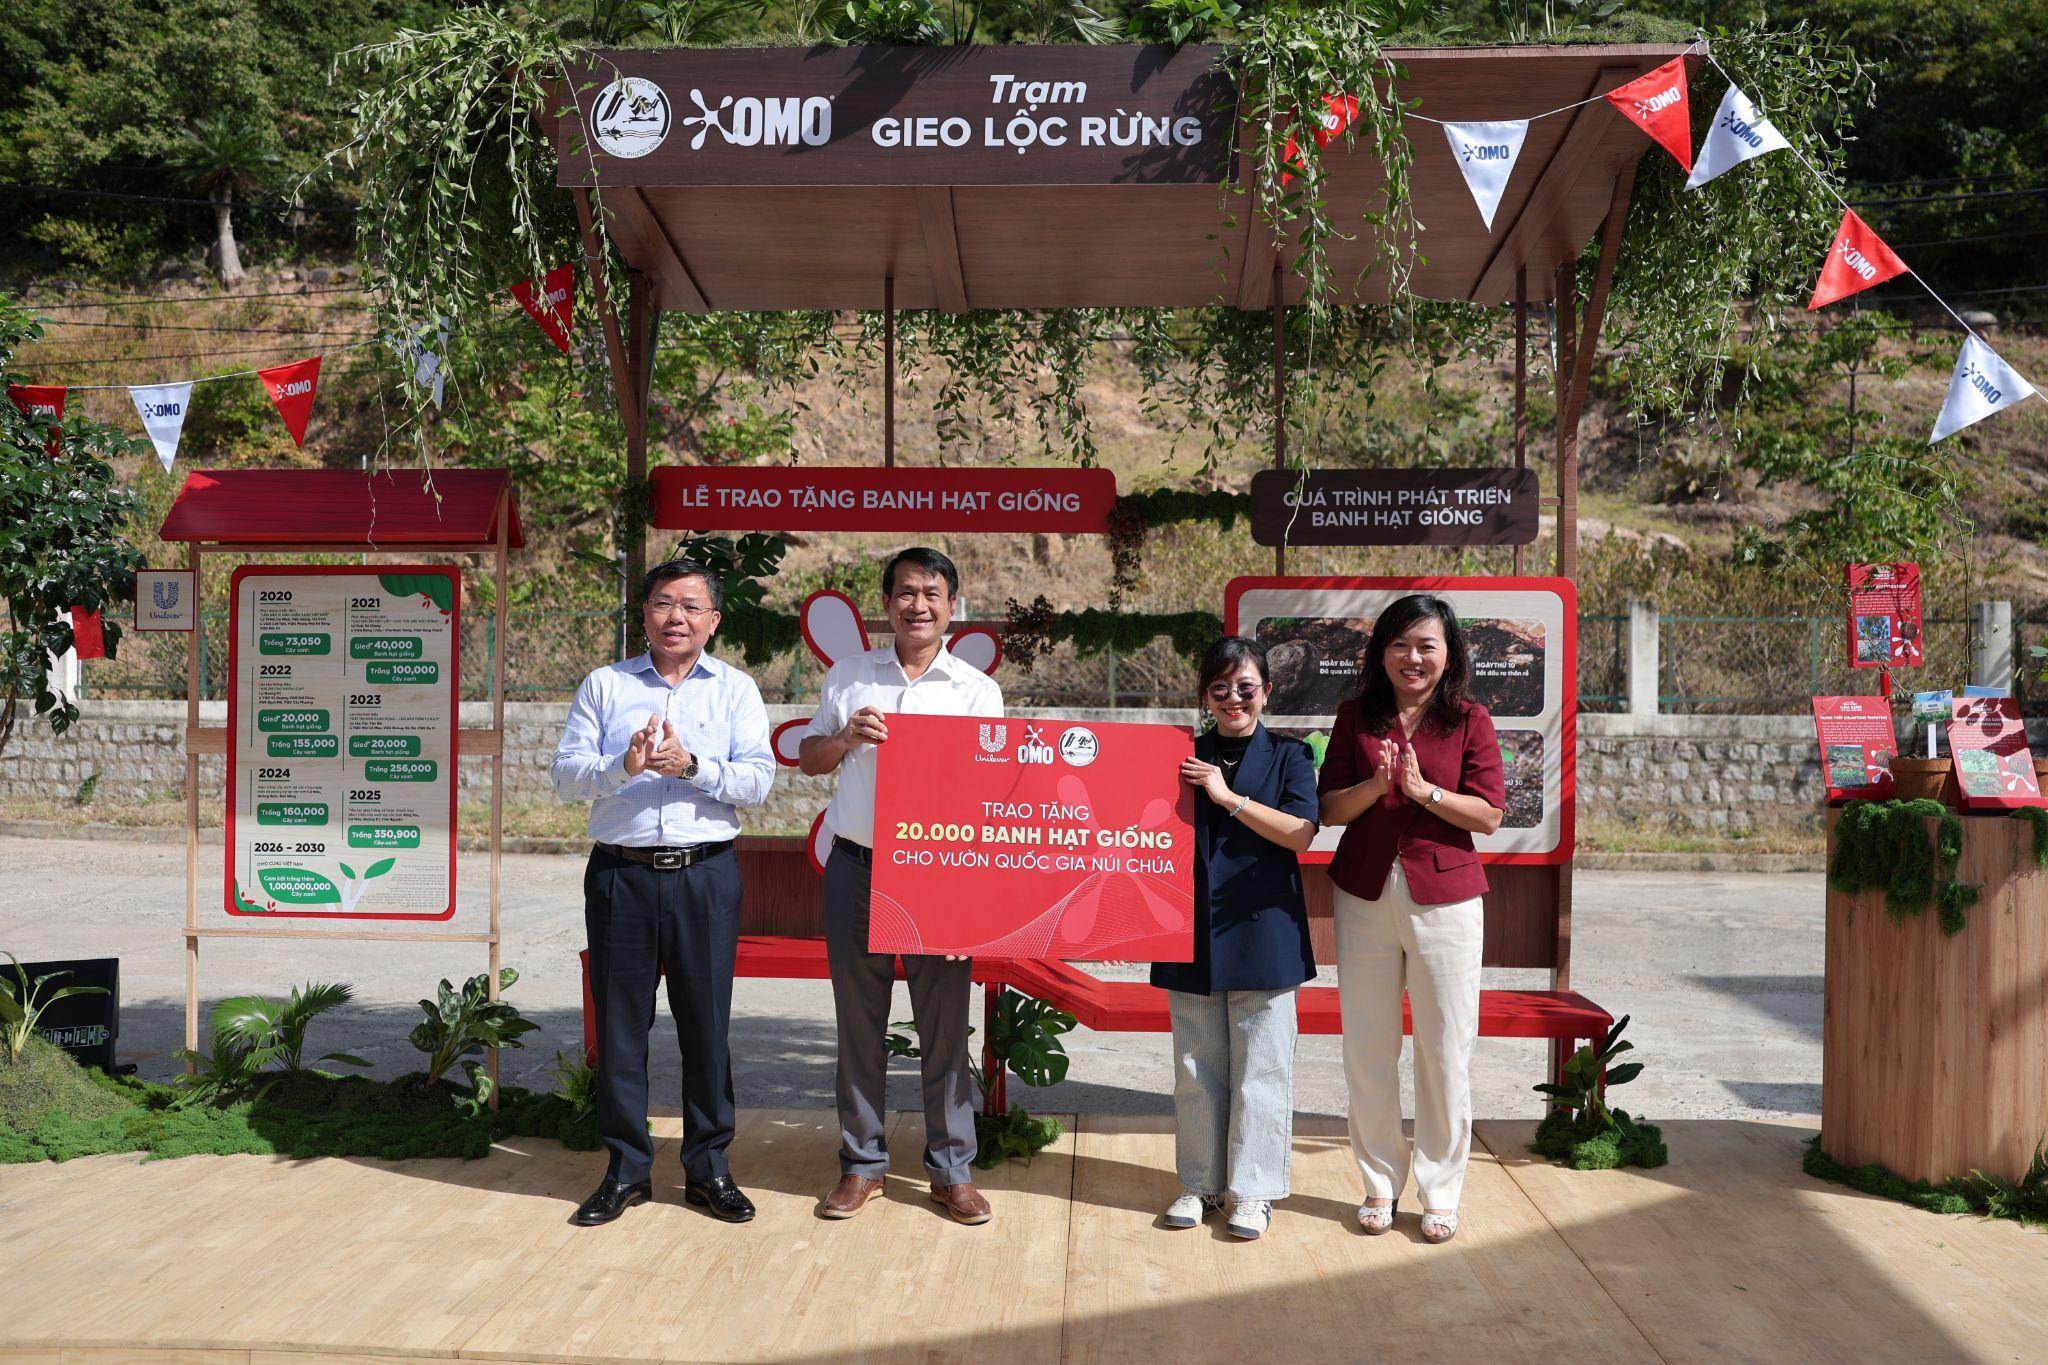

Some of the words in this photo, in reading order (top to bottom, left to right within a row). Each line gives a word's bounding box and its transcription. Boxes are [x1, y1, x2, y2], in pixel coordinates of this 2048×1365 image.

[989, 74, 1087, 111] Trạm
[1650, 86, 1682, 113] OMO
[733, 96, 832, 147] OMO
[871, 116, 972, 147] GIEO
[984, 108, 1068, 155] LỘC
[1081, 108, 1203, 147] RỪNG
[1734, 120, 1763, 149] OMO
[1478, 144, 1510, 160] OMO
[1846, 250, 1877, 281] OMO
[288, 379, 312, 396] OMO
[1974, 375, 2002, 405] OMO
[156, 403, 181, 417] OMO
[682, 484, 709, 507] LỄ
[716, 488, 782, 508] TRAO
[788, 486, 856, 513] TẶNG
[863, 489, 933, 510] BANH
[941, 490, 991, 515] HẠT
[997, 488, 1081, 513] GIỐNG
[1283, 486, 1327, 507] QUÁ
[1332, 486, 1392, 506] TRÌNH
[1398, 486, 1450, 506] PHÁT
[1454, 485, 1512, 505] TRIỂN
[1312, 511, 1368, 527] BANH
[1374, 511, 1413, 530] HẠT
[1418, 506, 1484, 526] GIỐNG
[260, 591, 292, 601] 2020
[351, 598, 380, 608] 2021
[286, 637, 321, 647] 73,050
[374, 640, 413, 651] 40,000
[1320, 659, 1338, 667] NGÀY
[260, 666, 292, 675] 2022
[392, 666, 436, 676] 100,000
[350, 695, 381, 705] 2023
[282, 714, 319, 723] 20,000
[293, 739, 336, 749] 155,000
[371, 739, 407, 749] 20,000
[974, 754, 1011, 763] Unilever
[1017, 744, 1055, 765] OMO
[259, 768, 291, 778] 2024
[390, 764, 432, 774] 256,000
[349, 790, 381, 800] 2025
[283, 807, 325, 817] 160,000
[981, 802, 1033, 819] TRAO
[1038, 800, 1090, 823] TẶNG
[374, 829, 418, 839] 350,900
[895, 822, 975, 842] 20.000
[981, 826, 1042, 845] BANH
[1048, 828, 1091, 851] HẠT
[1096, 824, 1173, 849] GIỐNG
[254, 842, 283, 853] 2026
[295, 842, 326, 853] 2030
[892, 850, 934, 866] CHO
[938, 850, 990, 868] VƯỜN
[994, 850, 1050, 870] QUỐC
[1055, 854, 1086, 872] GIA
[1091, 854, 1121, 873] NÚI
[1126, 855, 1175, 874] CHÚA
[268, 882, 331, 892] 1,000,000,000
